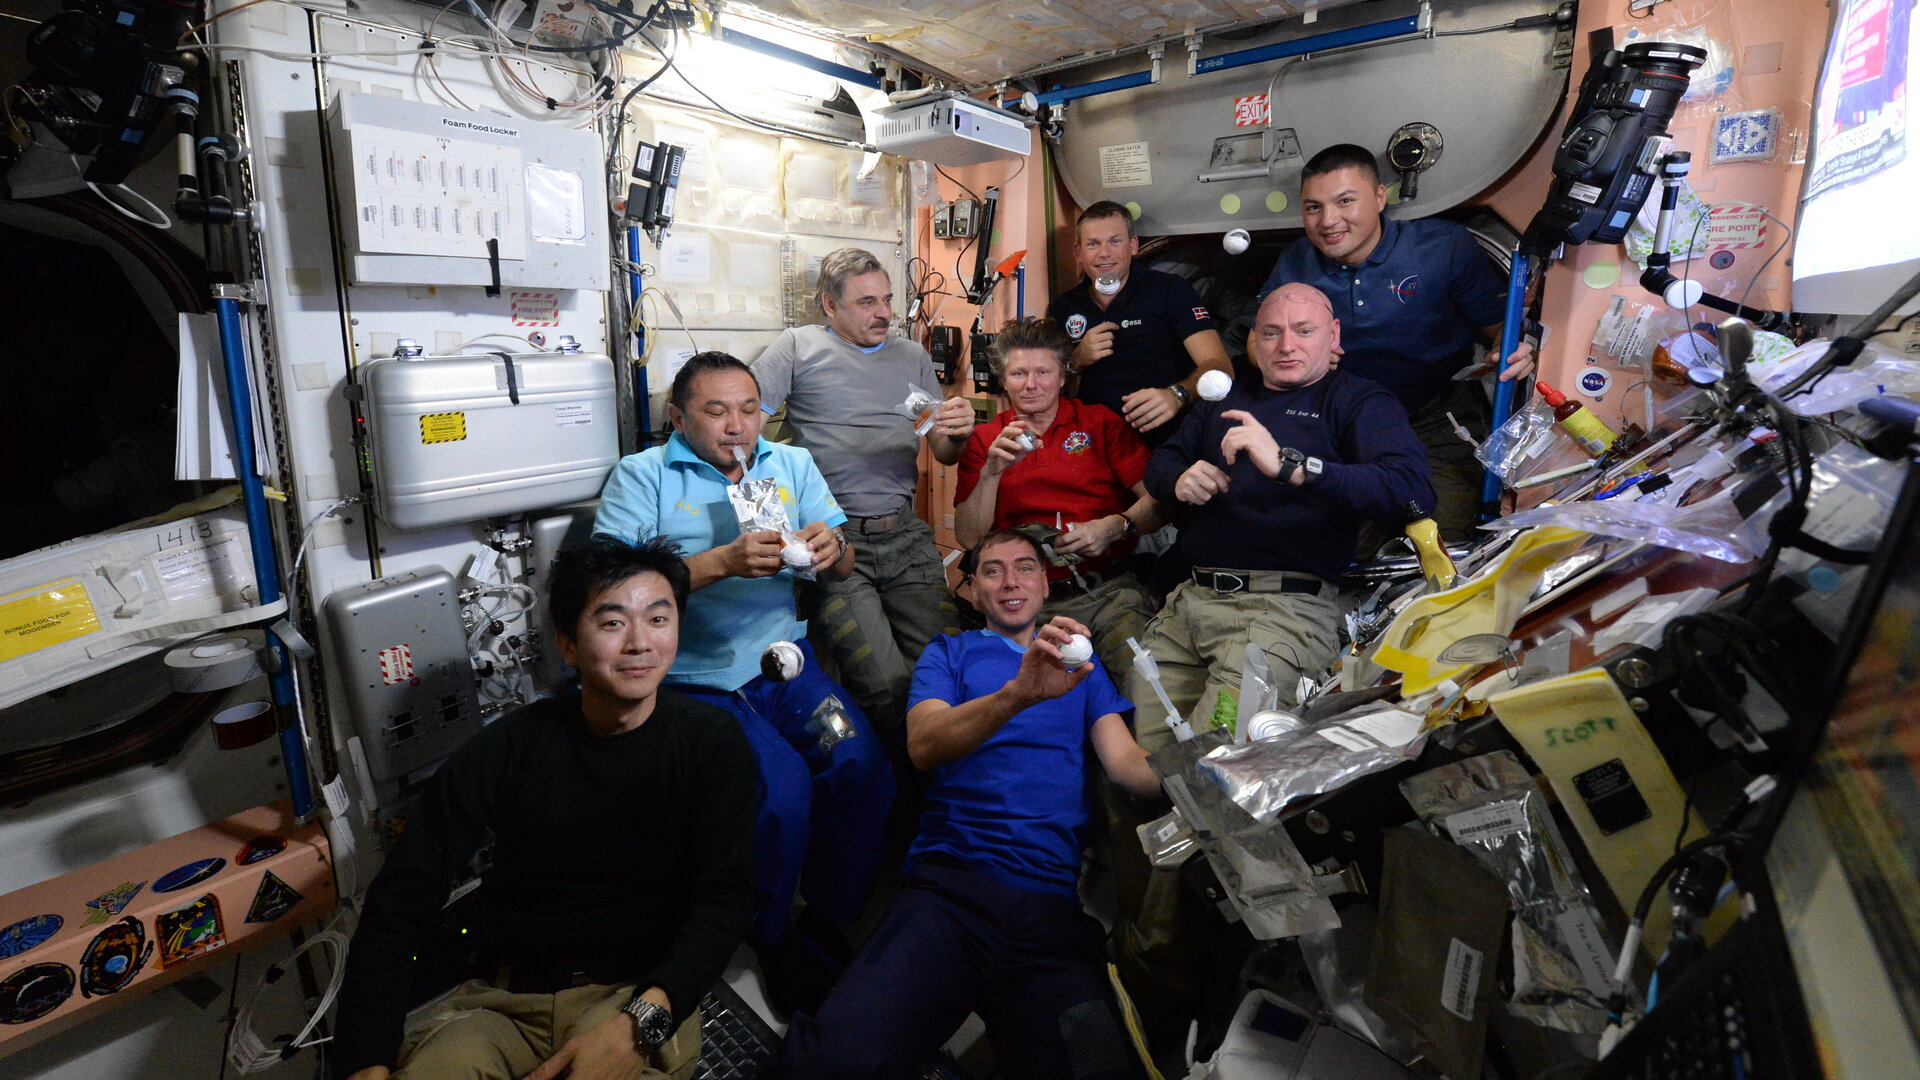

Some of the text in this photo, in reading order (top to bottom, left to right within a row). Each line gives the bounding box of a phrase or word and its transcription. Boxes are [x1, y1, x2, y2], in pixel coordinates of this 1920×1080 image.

[1240, 102, 1264, 119] EXIT
[443, 119, 518, 136] Foam Food Locker
[1561, 126, 1581, 149] Canon
[1728, 224, 1758, 232] PORT
[1583, 377, 1604, 387] NASA
[157, 521, 213, 552] 1413
[3, 610, 72, 635] BONUS FOOD FOR
[18, 620, 62, 637] MOGENSEN
[1545, 717, 1617, 747] SCOTT
[1576, 922, 1588, 940] Tea
